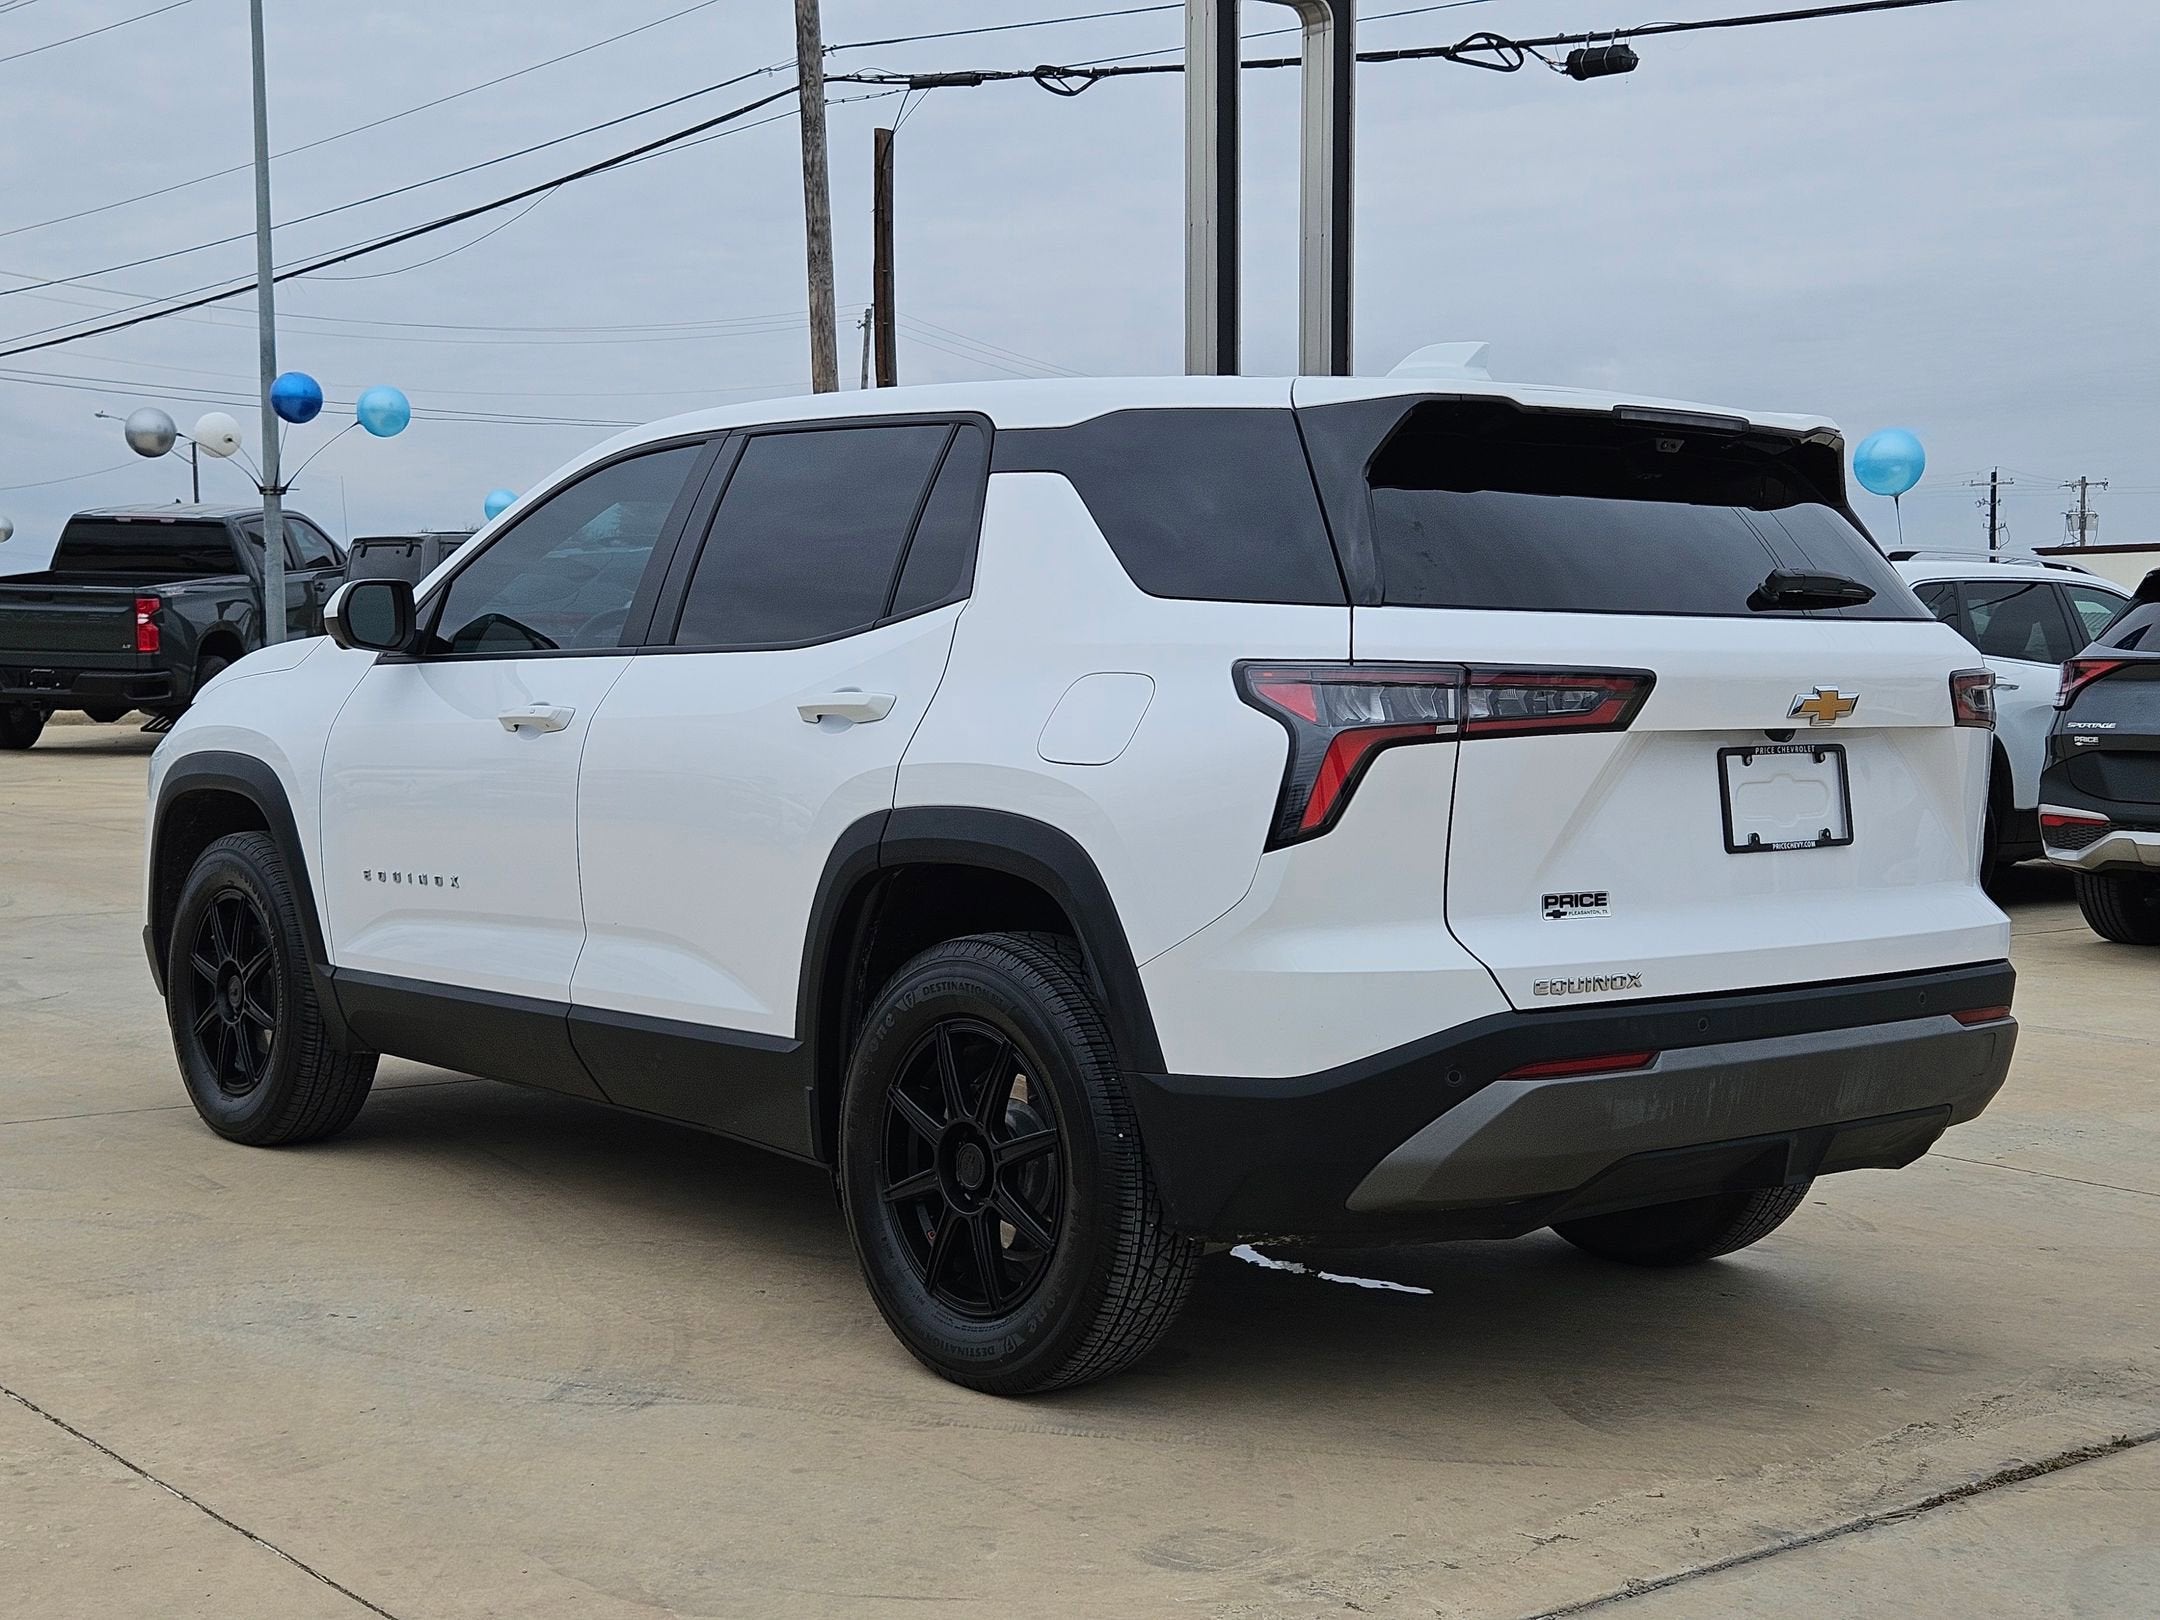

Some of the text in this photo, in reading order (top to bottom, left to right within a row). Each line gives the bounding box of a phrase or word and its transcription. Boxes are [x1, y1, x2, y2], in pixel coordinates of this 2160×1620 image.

[1755, 745, 1816, 755] PRICE CHEVROLET
[1772, 840, 1817, 850] PRICECHEVY.COM
[1543, 893, 1608, 910] PRICE
[1533, 972, 1642, 996] EQUINOX
